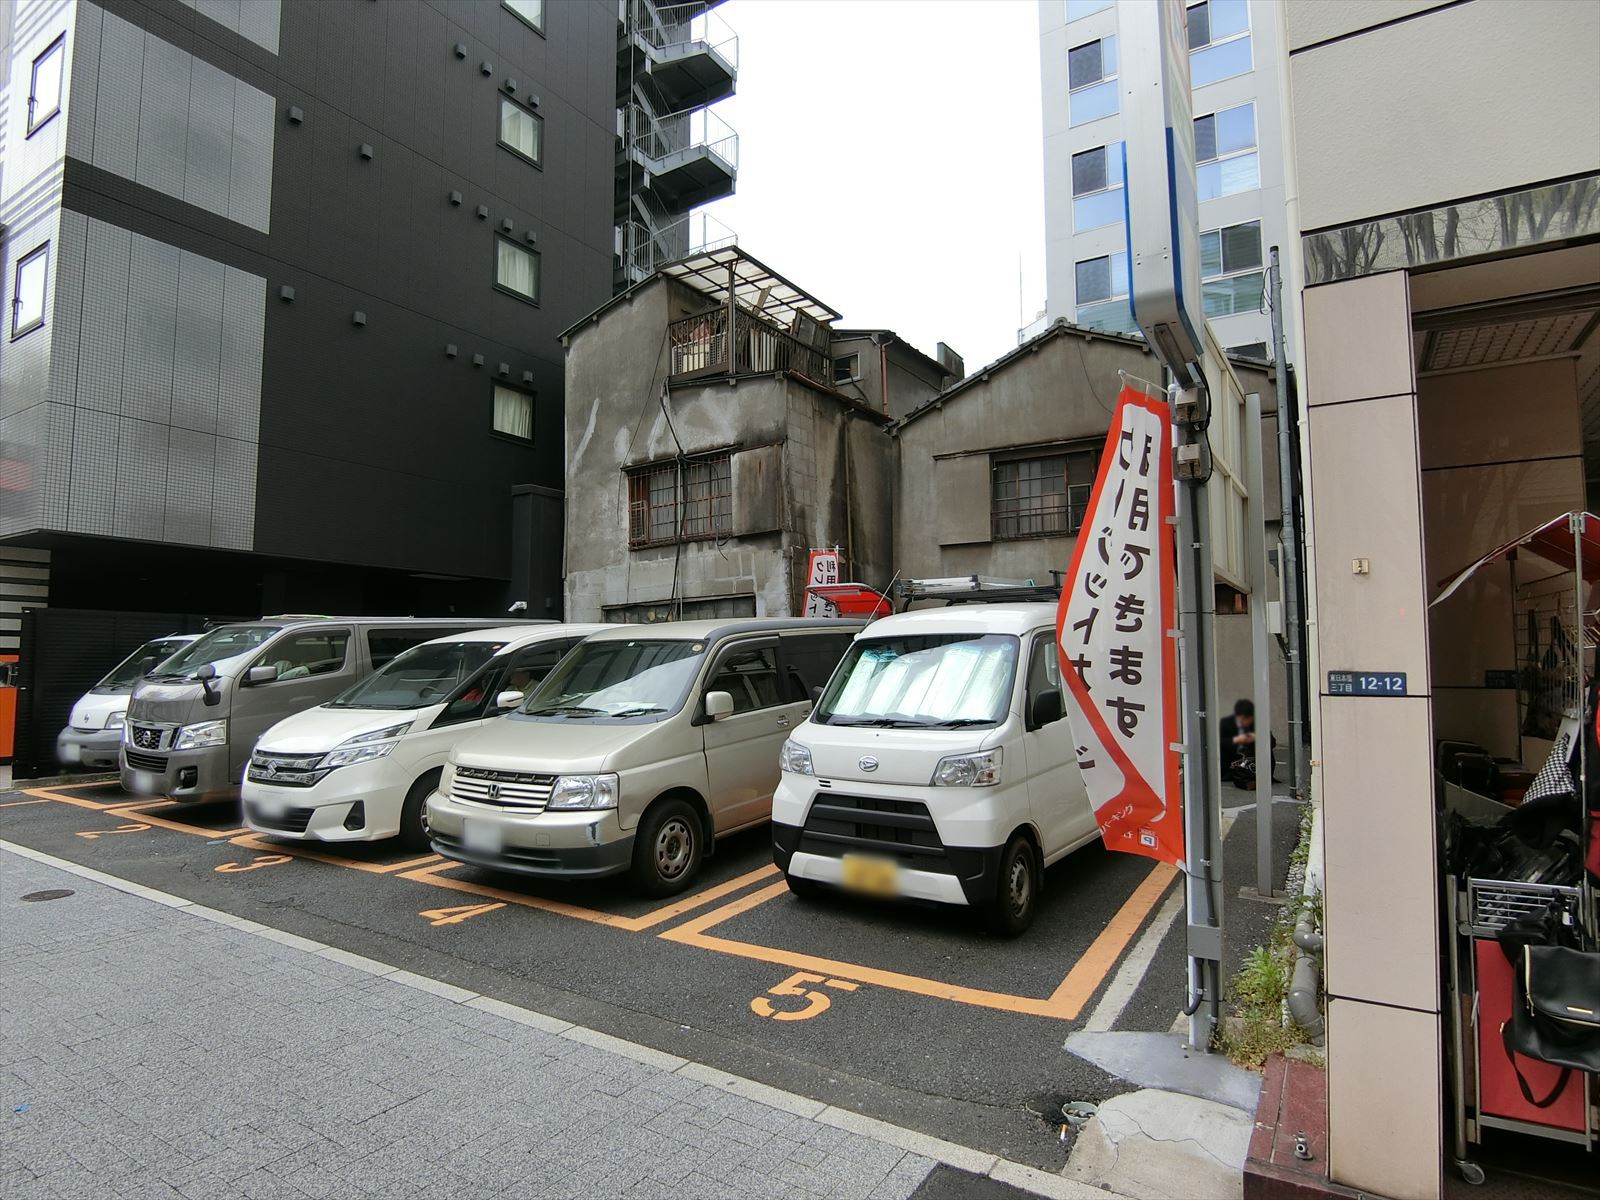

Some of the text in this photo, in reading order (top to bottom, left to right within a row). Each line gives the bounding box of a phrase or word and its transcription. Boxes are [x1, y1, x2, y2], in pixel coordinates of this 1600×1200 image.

[1330, 683, 1353, 692] 三丁目
[1360, 677, 1403, 691] 12-12
[75, 823, 152, 839] 2
[214, 854, 294, 873] 3
[418, 902, 507, 926] 4
[750, 971, 861, 1021] 5
